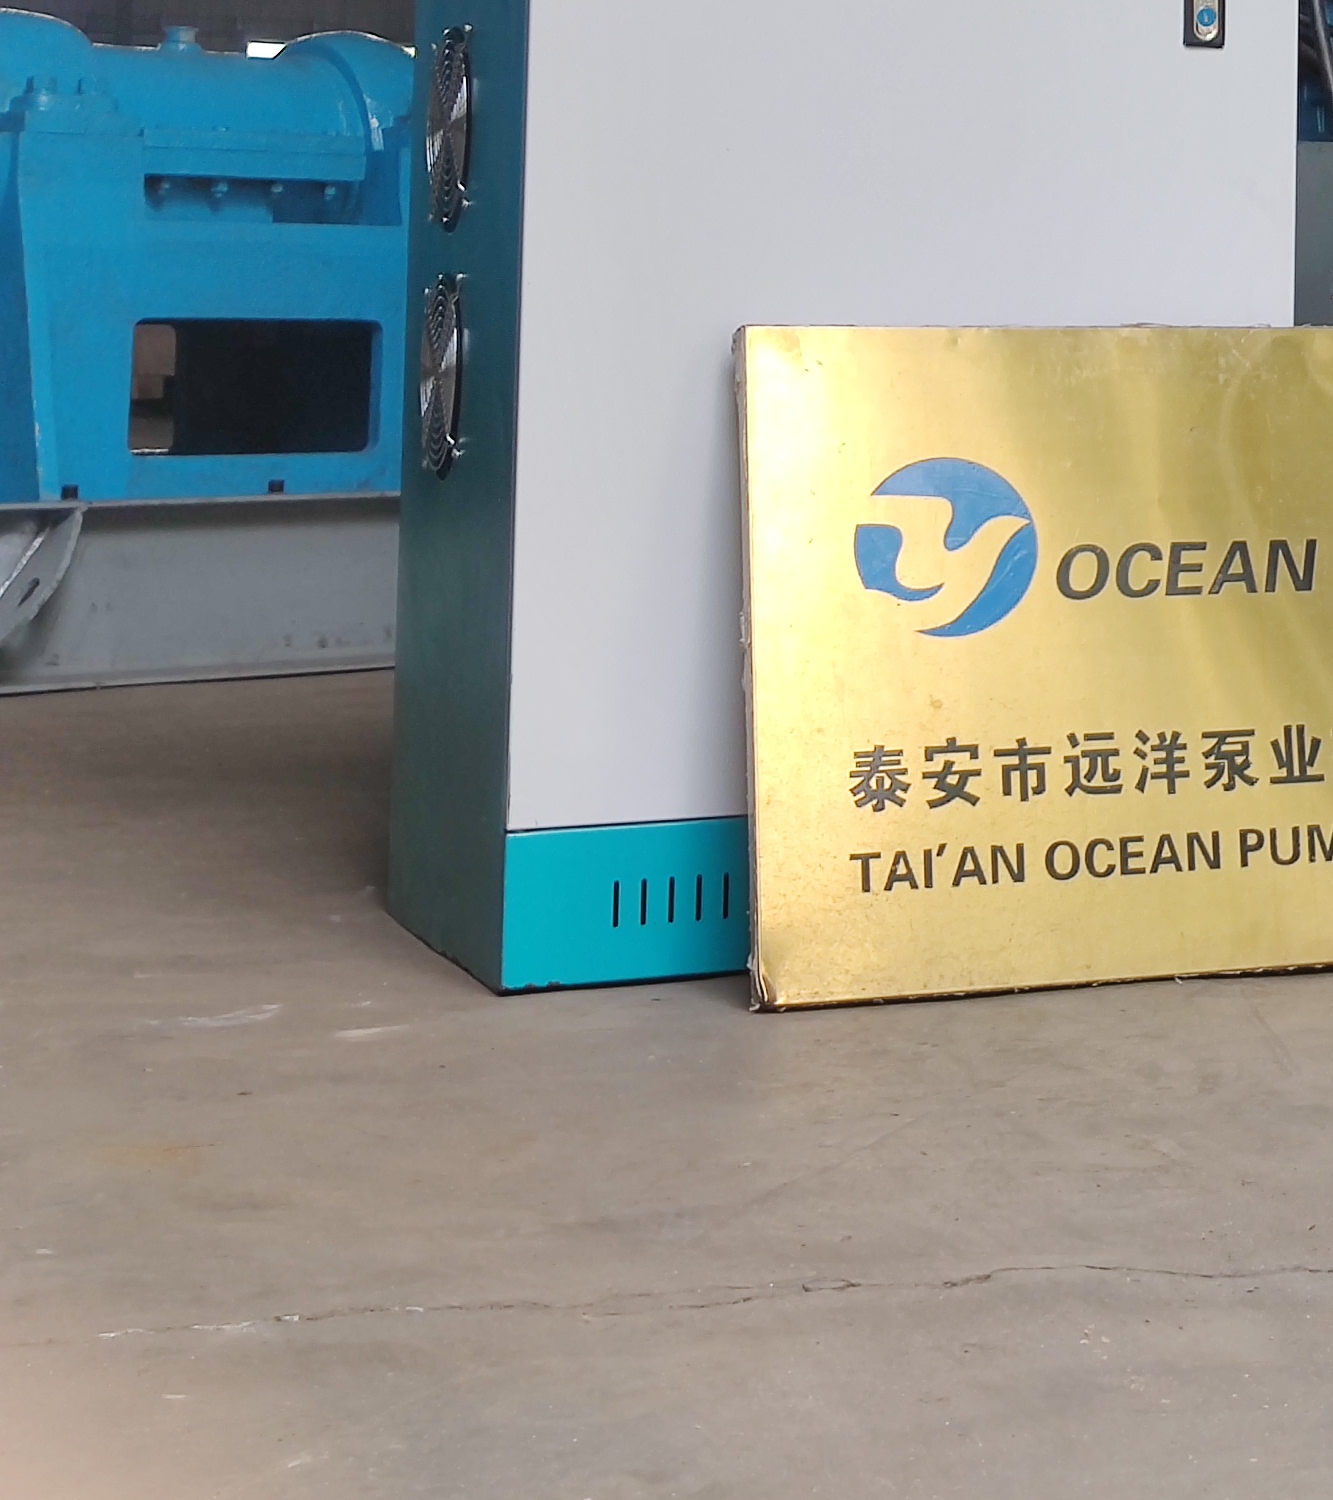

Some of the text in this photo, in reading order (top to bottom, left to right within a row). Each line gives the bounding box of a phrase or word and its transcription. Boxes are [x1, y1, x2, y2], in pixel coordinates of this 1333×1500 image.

[1056, 538, 1317, 600] OCEAN
[849, 843, 1025, 893] TAI'AN
[1045, 830, 1221, 881] OCEAN
